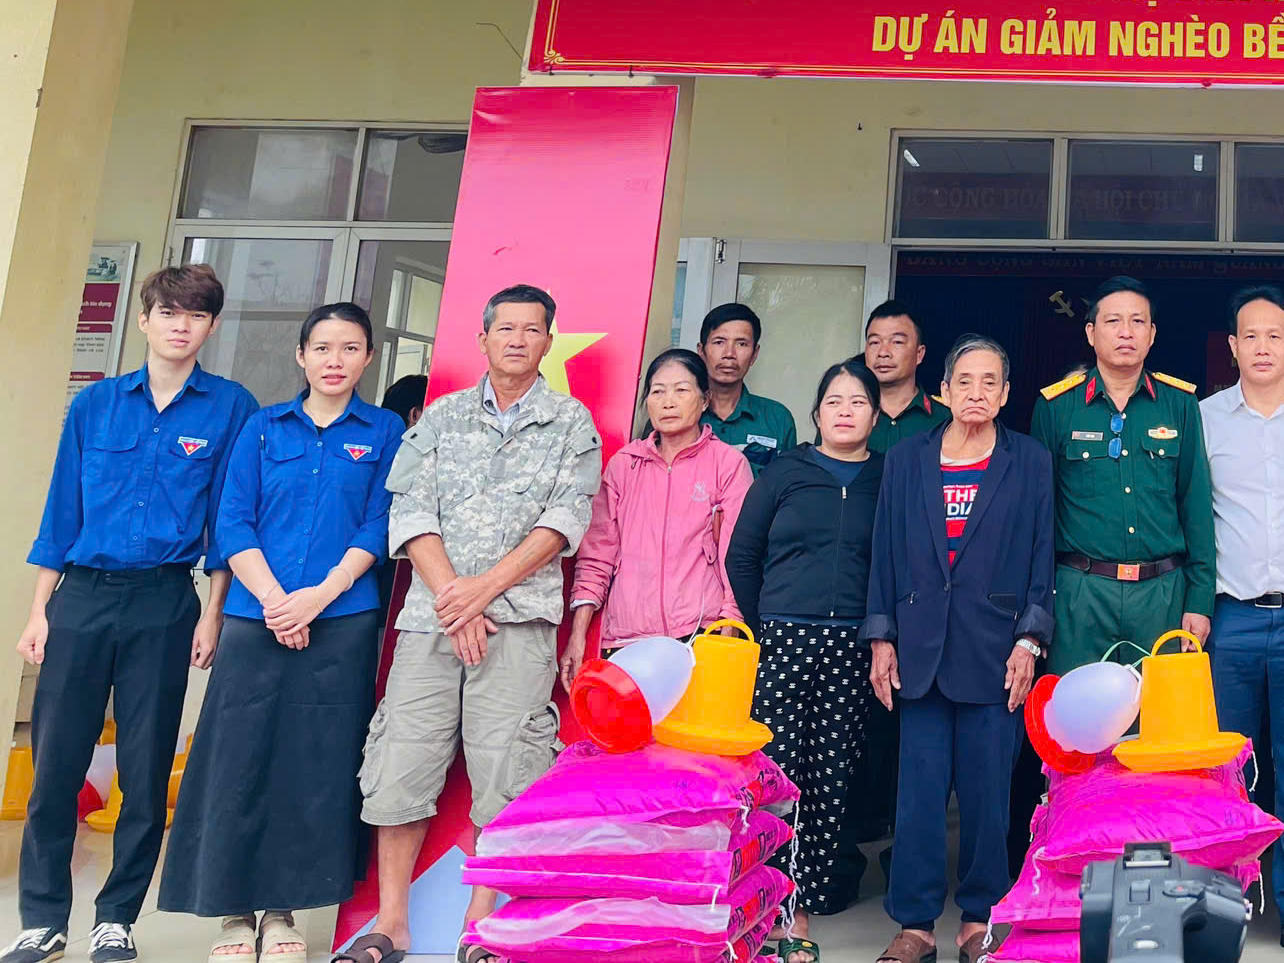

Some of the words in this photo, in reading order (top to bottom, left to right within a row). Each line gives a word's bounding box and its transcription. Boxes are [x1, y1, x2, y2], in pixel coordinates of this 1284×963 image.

[872, 14, 929, 60] DỰ
[934, 13, 988, 55] ÁN
[1000, 7, 1096, 57] GIẢM
[1109, 13, 1230, 58] NGHÈO
